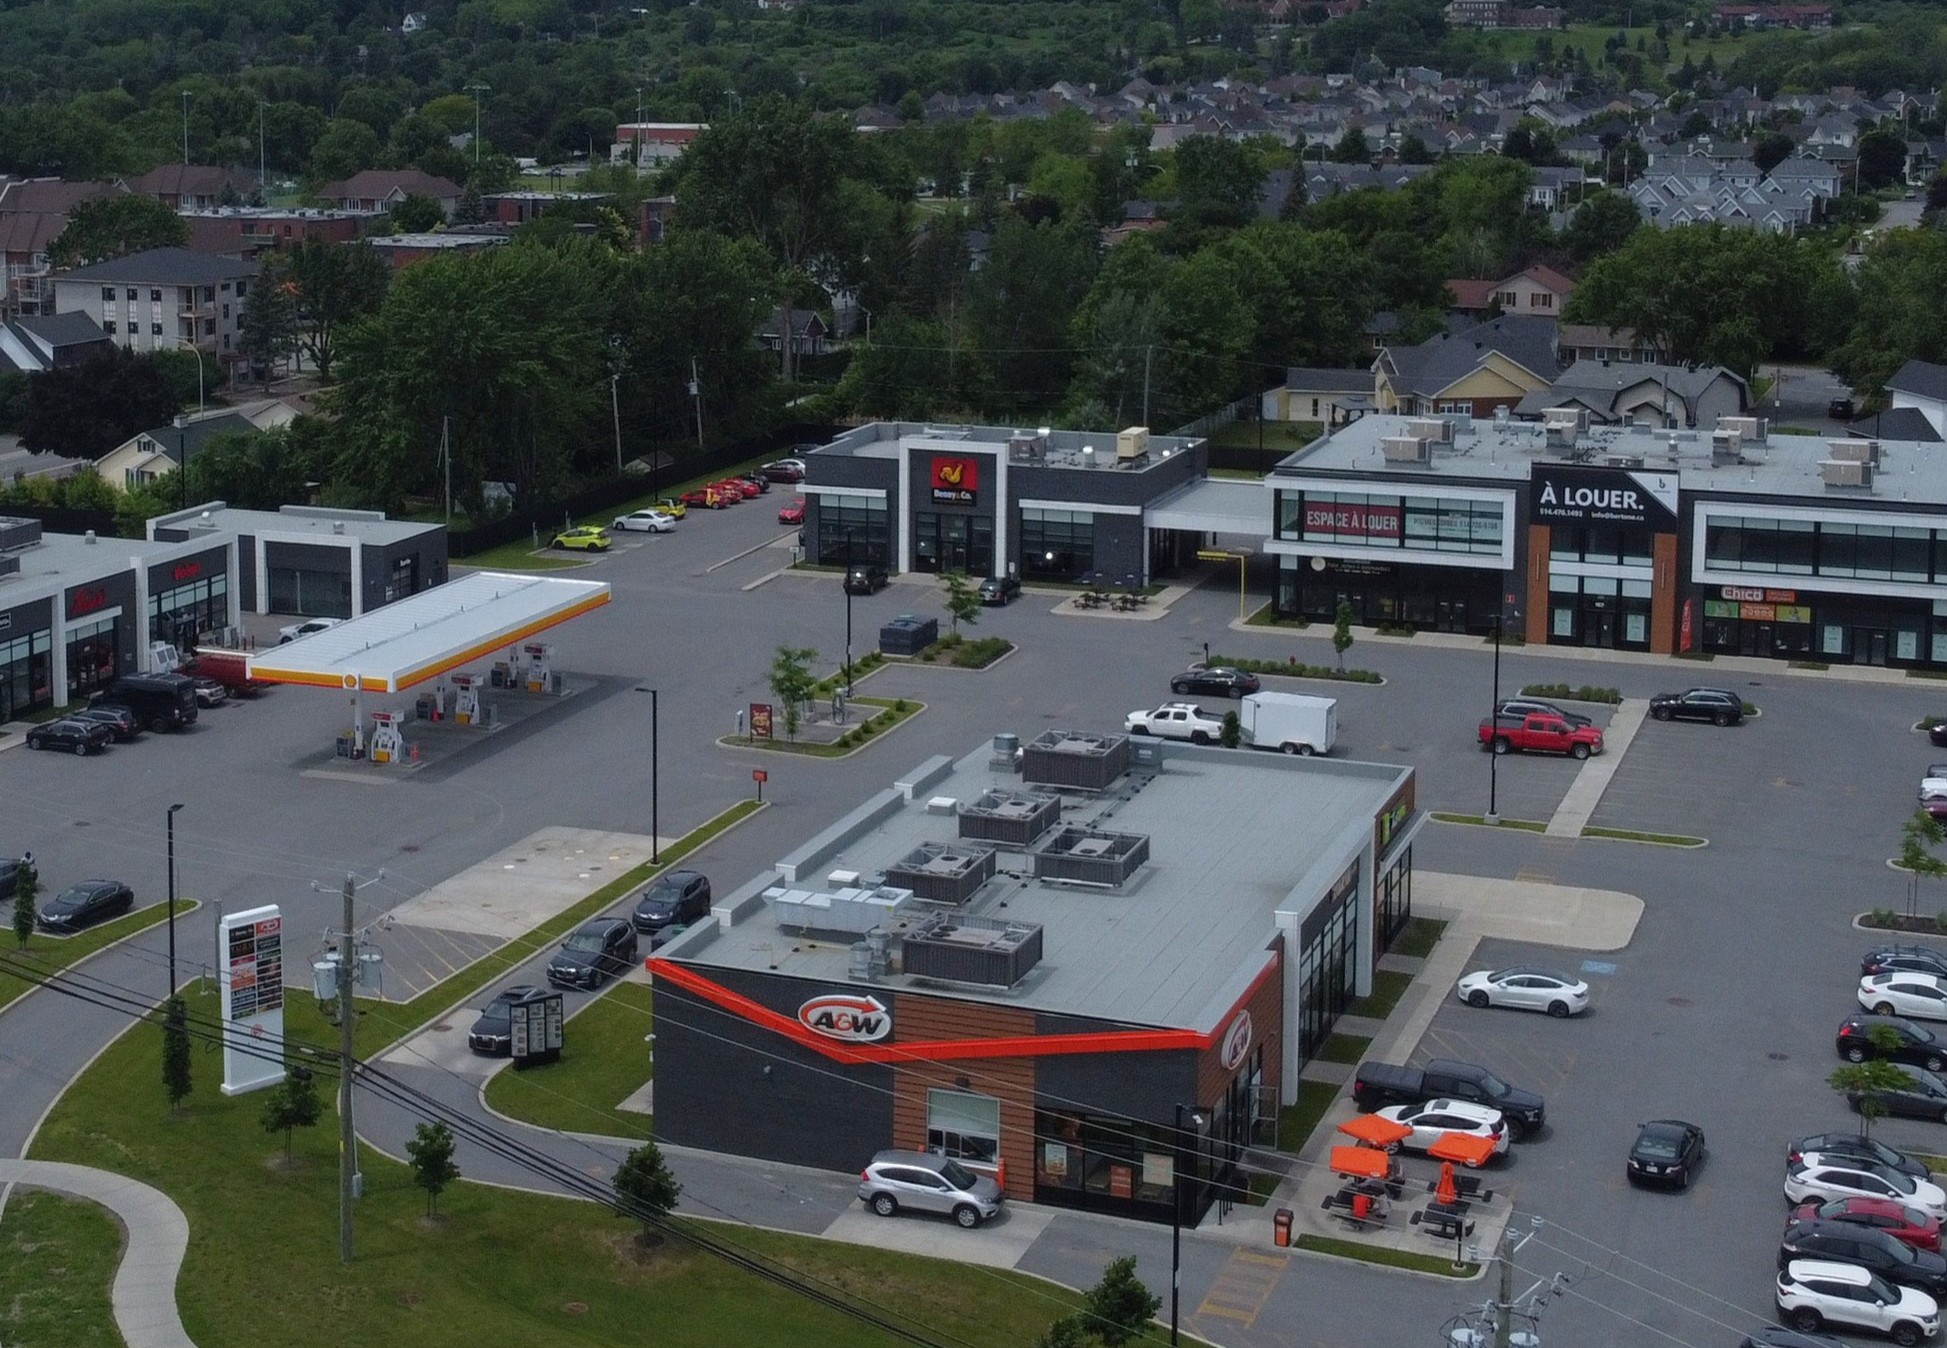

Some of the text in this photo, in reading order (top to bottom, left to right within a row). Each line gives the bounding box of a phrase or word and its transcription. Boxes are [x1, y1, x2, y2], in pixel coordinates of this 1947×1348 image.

[1540, 481, 1644, 510] À LOUER.
[1307, 511, 1349, 528] ESPACE
[1351, 511, 1359, 528] À
[1362, 515, 1398, 531] LOUER
[1722, 587, 1763, 600] Chico
[813, 1011, 883, 1035] A&W
